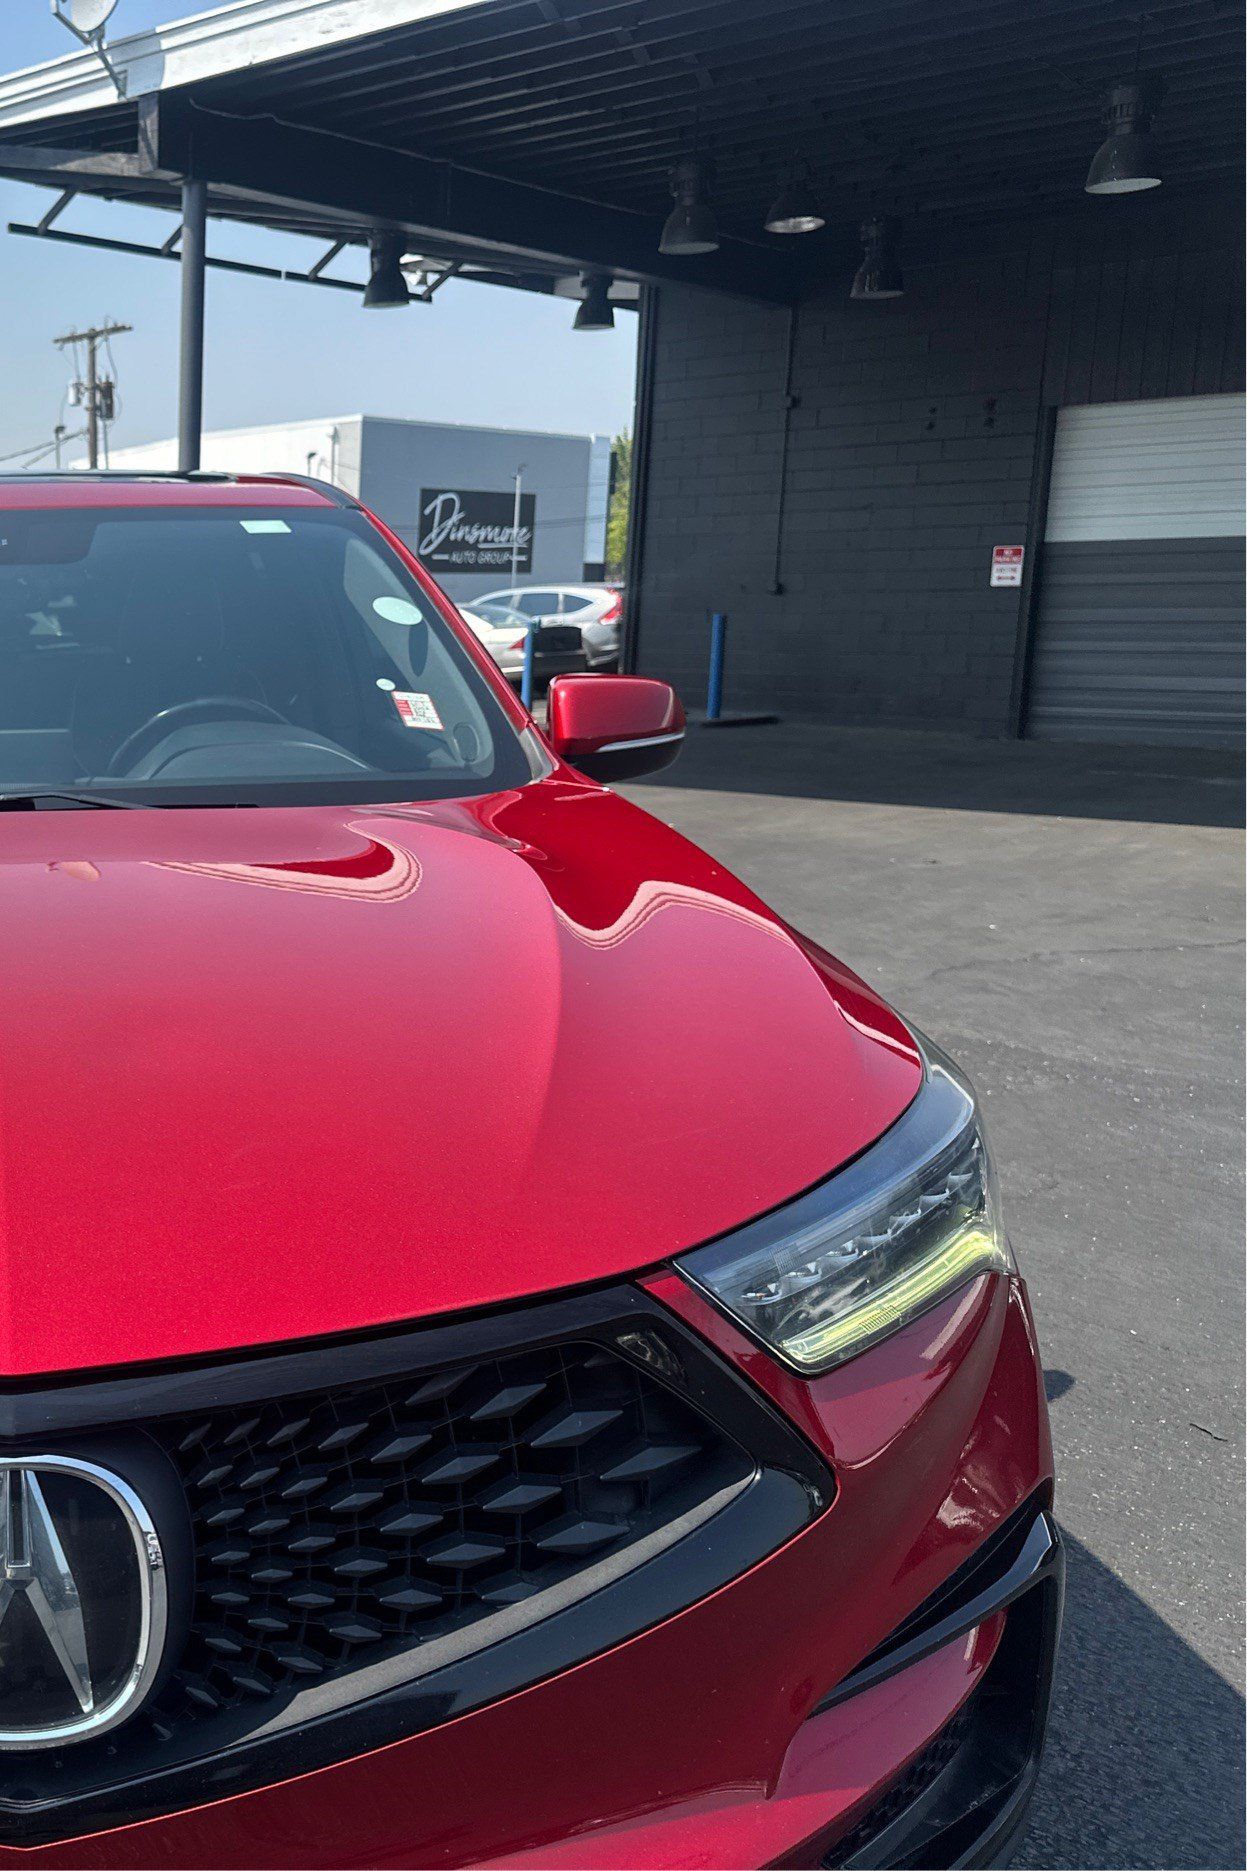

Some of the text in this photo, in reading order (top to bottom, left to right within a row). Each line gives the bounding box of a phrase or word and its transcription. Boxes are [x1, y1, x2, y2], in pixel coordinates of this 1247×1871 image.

[419, 492, 532, 555] Dinsmore
[450, 551, 510, 565] AUTO GROUP
